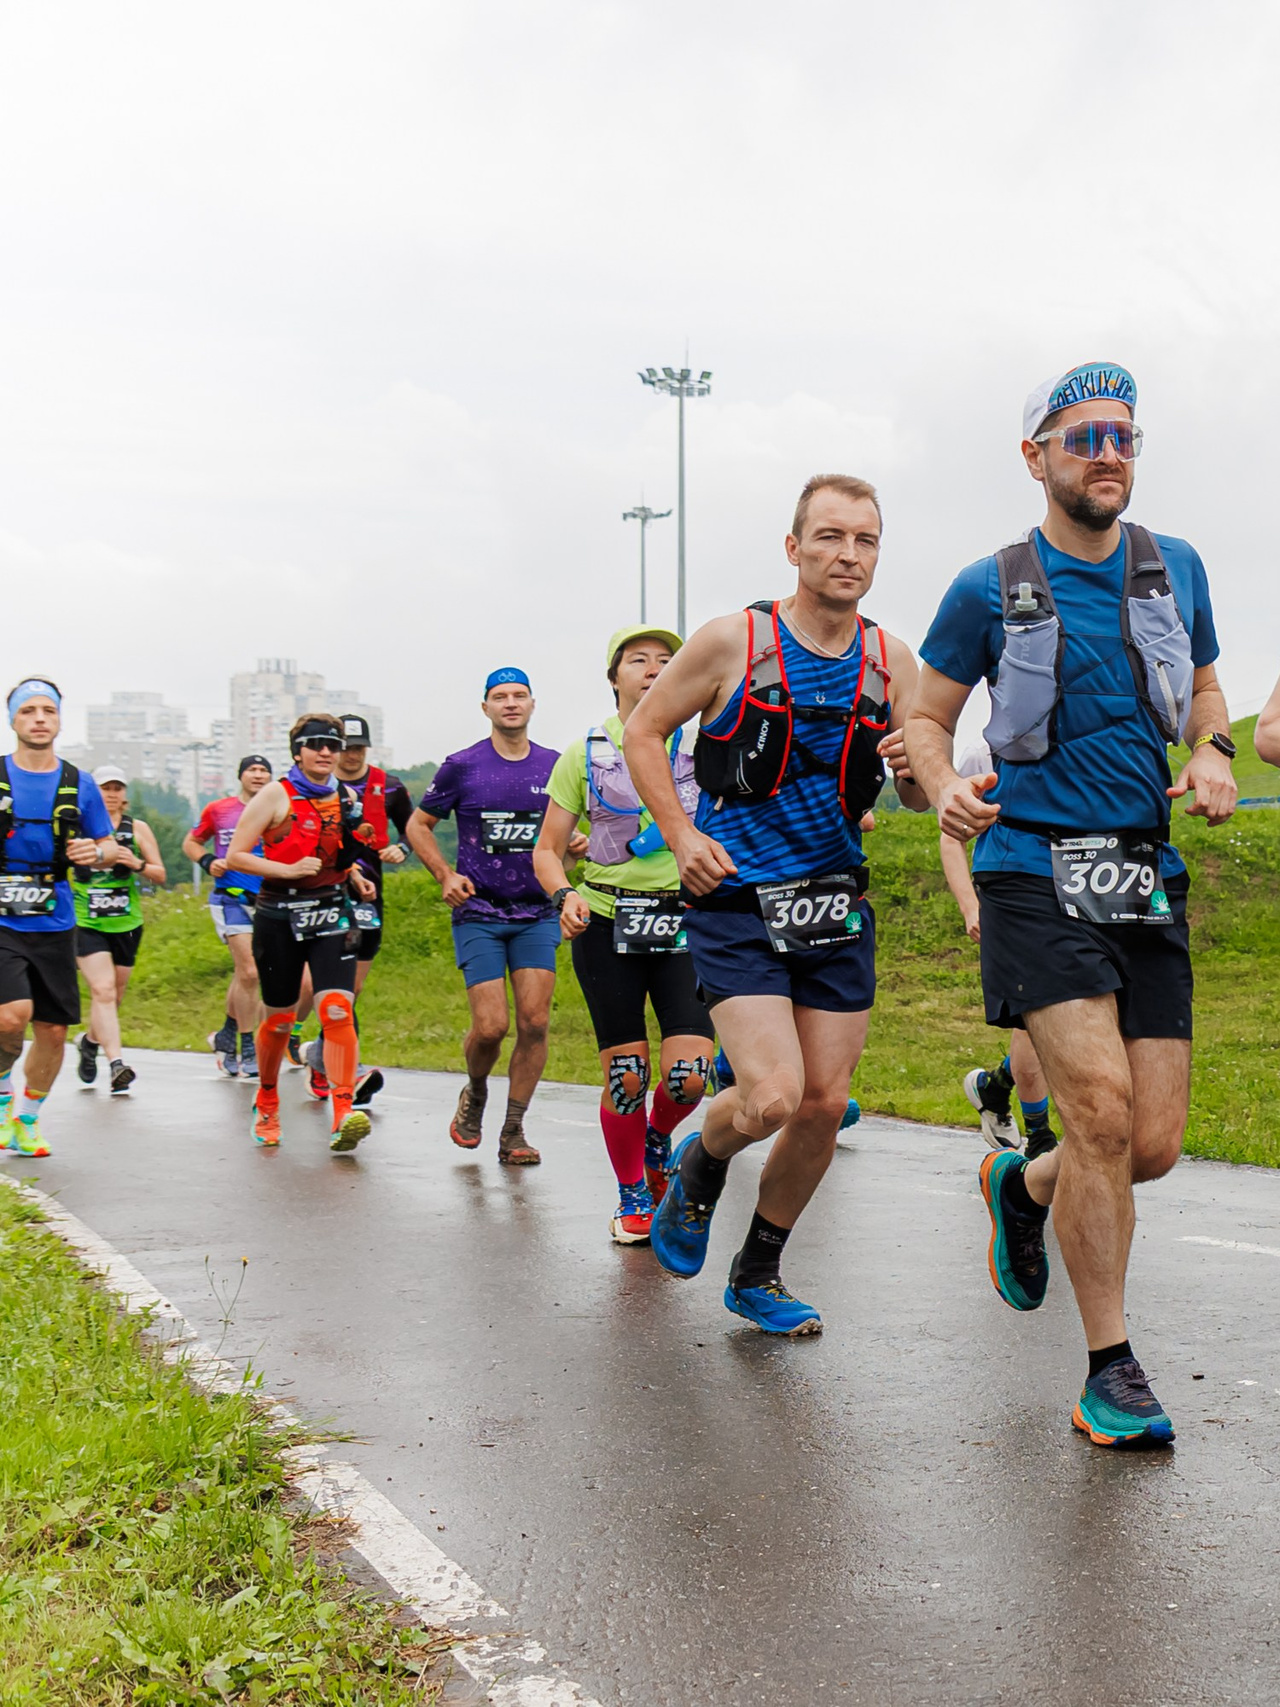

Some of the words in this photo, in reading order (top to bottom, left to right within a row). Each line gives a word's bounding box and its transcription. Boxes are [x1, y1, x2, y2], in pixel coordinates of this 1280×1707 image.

[489, 824, 537, 840] 3173
[1083, 851, 1097, 860] 30
[1062, 862, 1155, 896] 3079
[0, 886, 53, 903] 3107
[785, 890, 795, 898] 30
[296, 907, 340, 928] 3176
[770, 893, 851, 929] 3078
[623, 914, 683, 936] 3163
